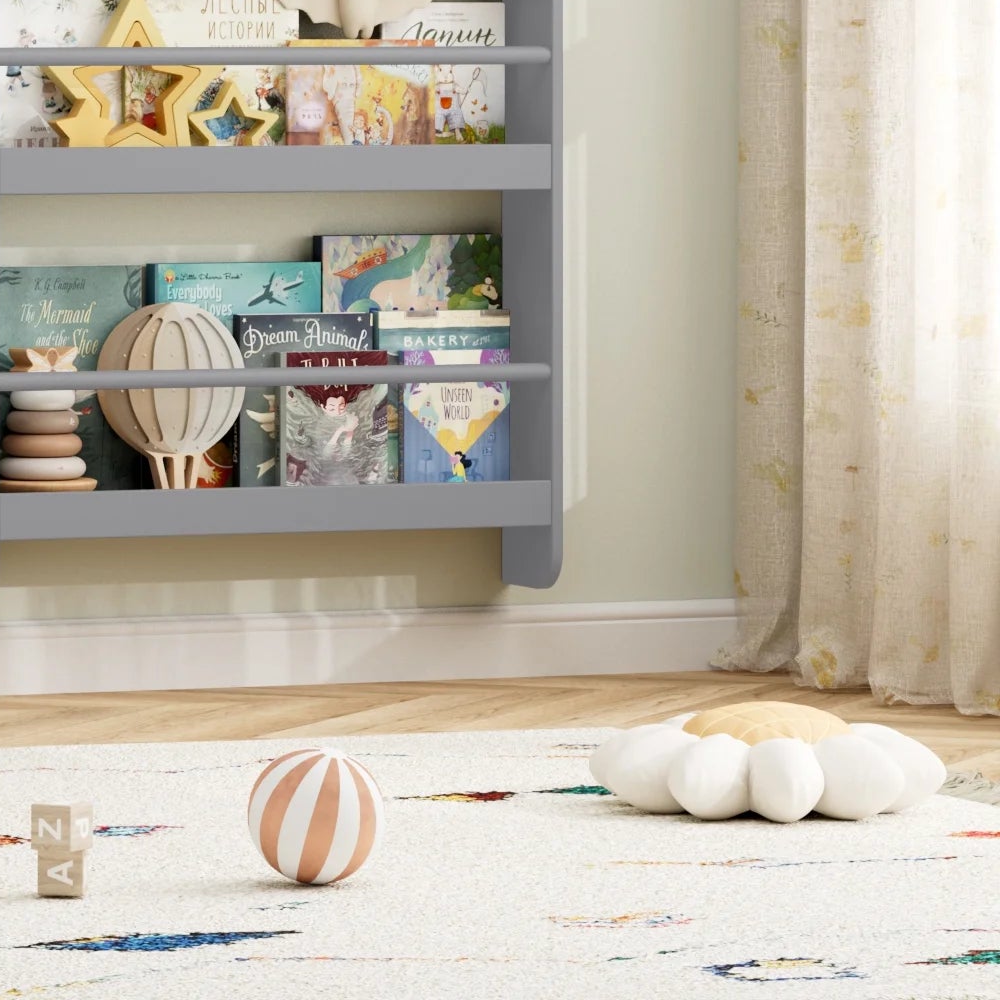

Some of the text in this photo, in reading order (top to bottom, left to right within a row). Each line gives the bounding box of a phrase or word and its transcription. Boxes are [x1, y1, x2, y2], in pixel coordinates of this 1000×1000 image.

[208, 20, 275, 40] ИСТОРИИ
[401, 20, 497, 48] Лапин
[53, 276, 86, 293] Campbell
[166, 283, 222, 302] Everybody
[20, 299, 97, 328] The Mermaid
[204, 301, 233, 317] Loves
[35, 330, 55, 347] and
[73, 327, 99, 358] Shoe
[242, 319, 369, 359] Dream Animals
[403, 334, 469, 348] BAKERY
[440, 386, 473, 404] UNSEEN
[443, 403, 471, 421] WORLD
[46, 859, 74, 887] A
